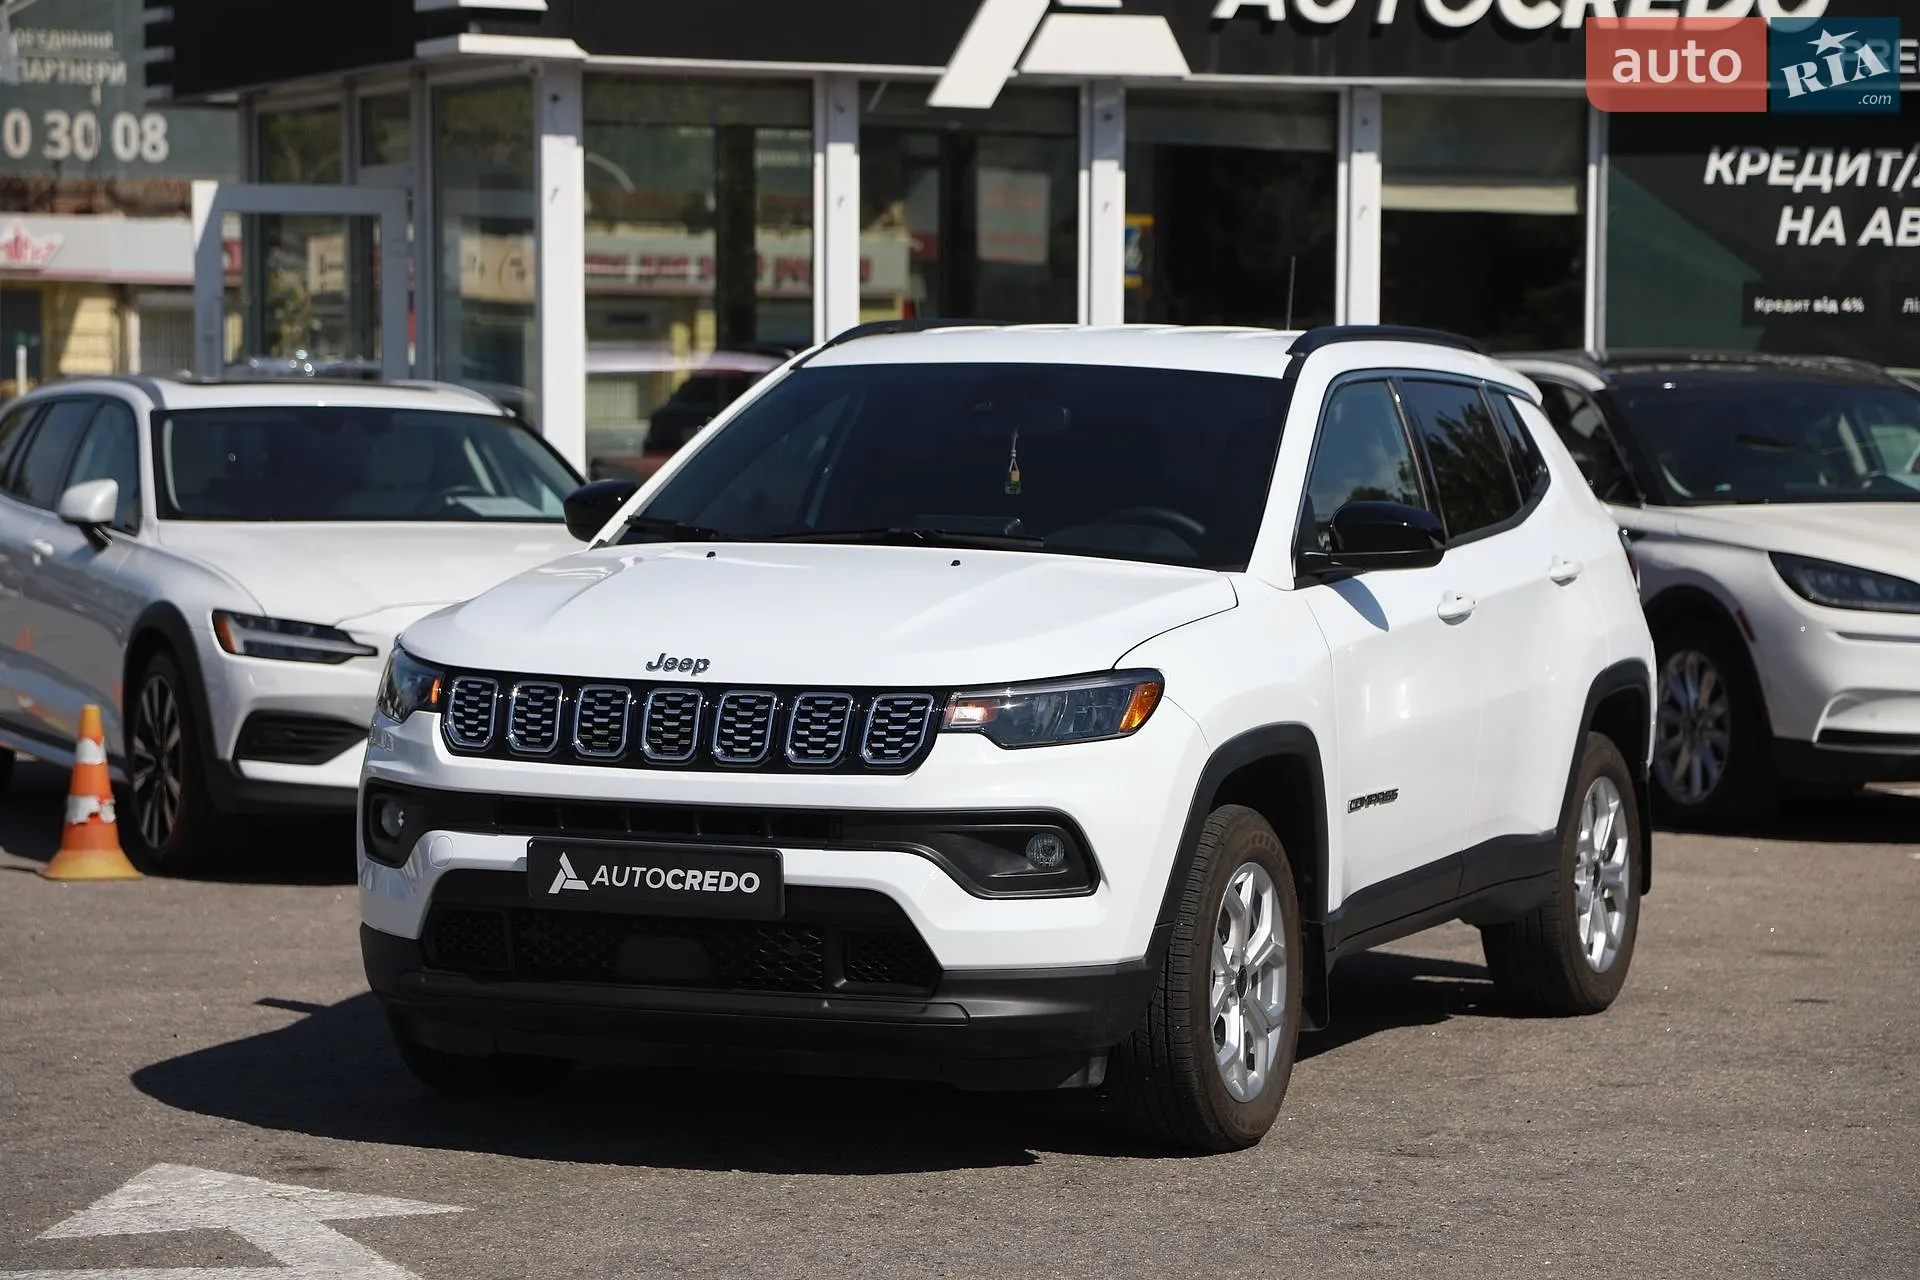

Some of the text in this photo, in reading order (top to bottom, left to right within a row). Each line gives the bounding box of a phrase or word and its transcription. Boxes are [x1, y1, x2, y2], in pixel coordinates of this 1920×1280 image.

[1840, 38, 1920, 74] PRE
[43, 109, 99, 162] 30
[112, 111, 170, 163] 08
[1704, 145, 1920, 193] КРЕДИТ/
[1775, 205, 1847, 246] НА
[1754, 295, 1865, 315] Кредит від 4%
[645, 653, 711, 677] Jeep
[591, 865, 761, 893] AUTOCREDO
